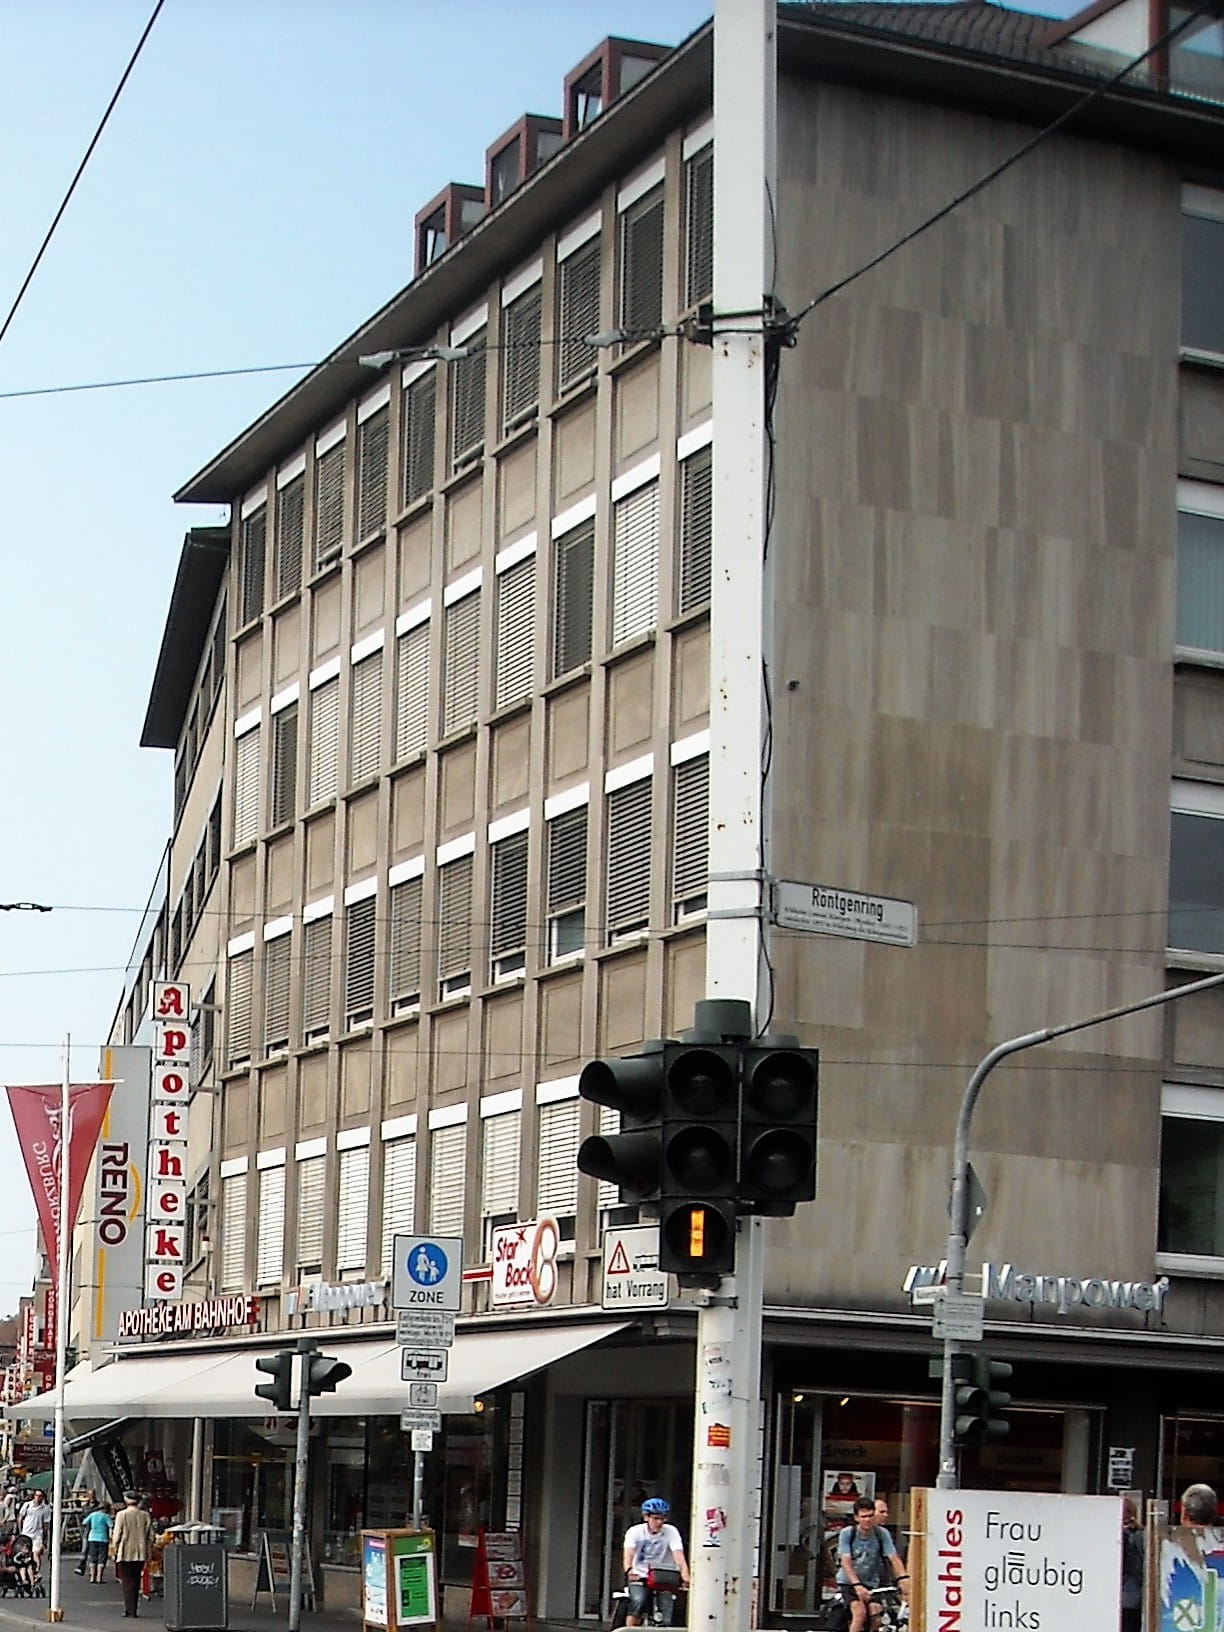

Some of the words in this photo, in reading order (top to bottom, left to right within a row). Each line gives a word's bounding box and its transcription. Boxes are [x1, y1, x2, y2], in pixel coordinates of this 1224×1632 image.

[812, 888, 883, 921] Röntgenring
[155, 986, 187, 1292] Apotheke
[99, 1142, 128, 1246] RENO
[496, 1237, 519, 1262] Star
[409, 1291, 444, 1304] ZONE
[606, 1281, 622, 1298] hat
[627, 1280, 664, 1301] Vorrang
[982, 1262, 1170, 1316] Manpower
[118, 1306, 173, 1336] APOTHEKE
[174, 1303, 192, 1331] AM
[194, 1296, 252, 1329] BAHNHOF
[986, 1511, 1042, 1542] Frau
[984, 1600, 1041, 1630] links
